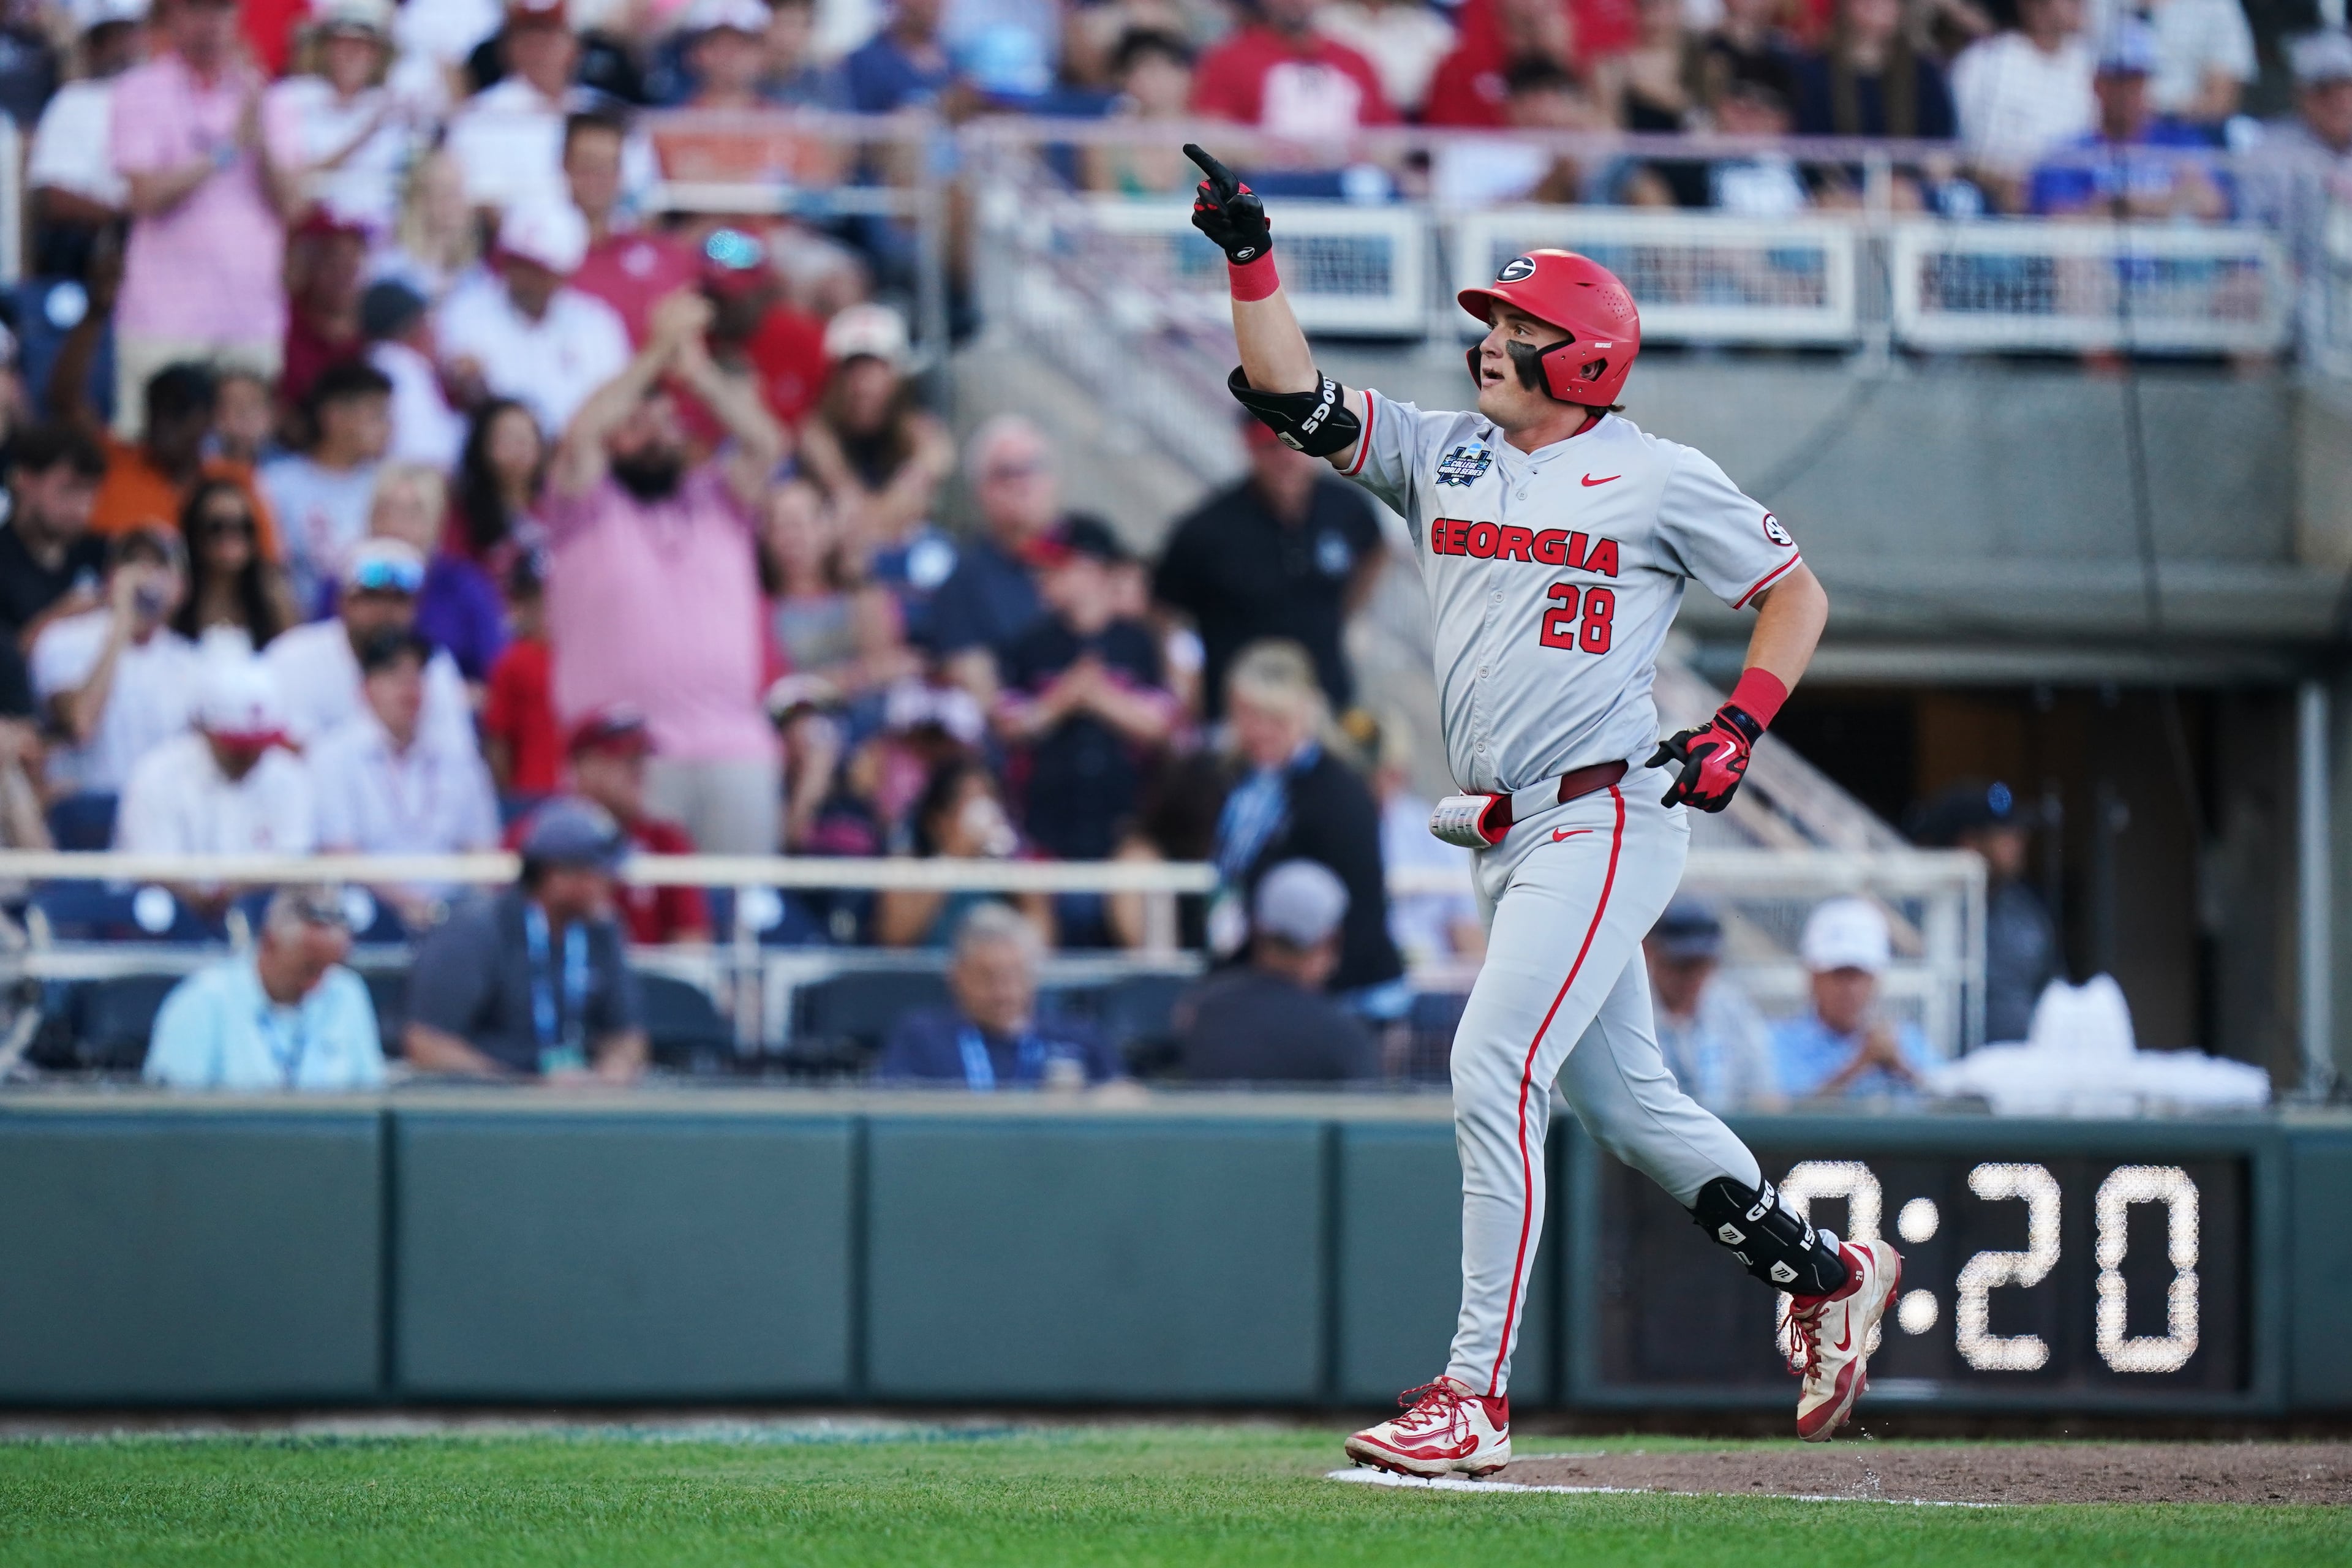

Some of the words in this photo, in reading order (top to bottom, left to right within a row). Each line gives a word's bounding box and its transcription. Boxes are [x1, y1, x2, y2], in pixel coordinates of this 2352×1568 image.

[1450, 460, 1479, 469] COLLEGE
[1460, 468, 1484, 477] SERIES
[1431, 518, 1618, 577] GEORGIA
[1540, 582, 1615, 654] 28
[1856, 1270, 1863, 1281] 28
